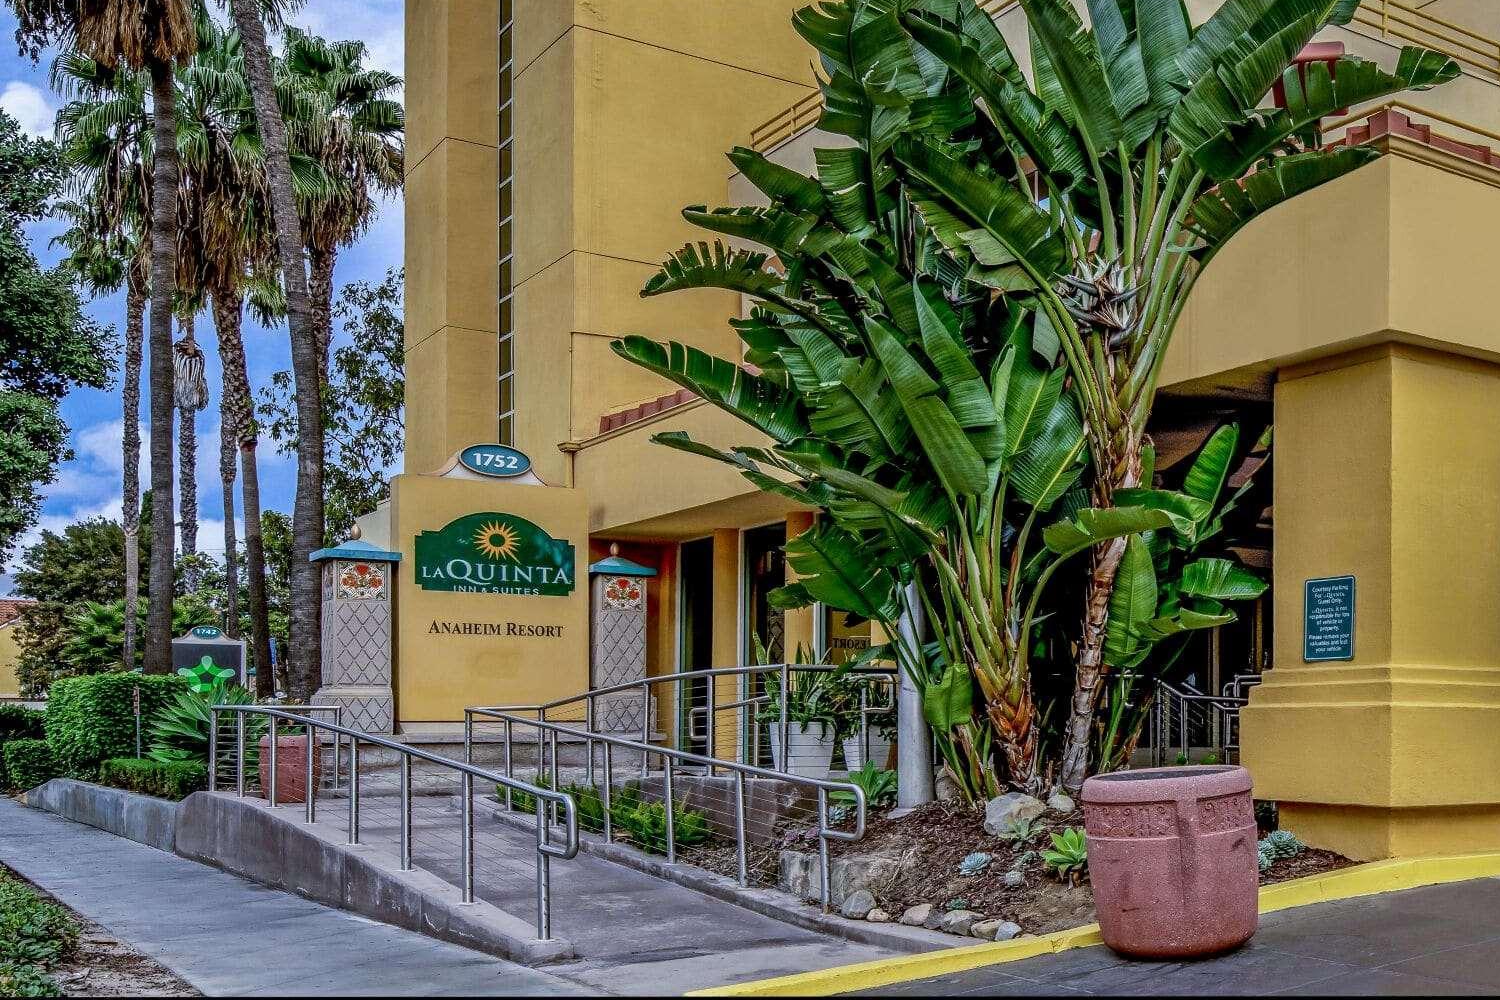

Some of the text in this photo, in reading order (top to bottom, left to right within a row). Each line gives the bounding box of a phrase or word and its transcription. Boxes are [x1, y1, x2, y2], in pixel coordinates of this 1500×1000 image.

[473, 452, 518, 469] 1752
[453, 584, 477, 593] INN
[492, 586, 540, 596] SUITES
